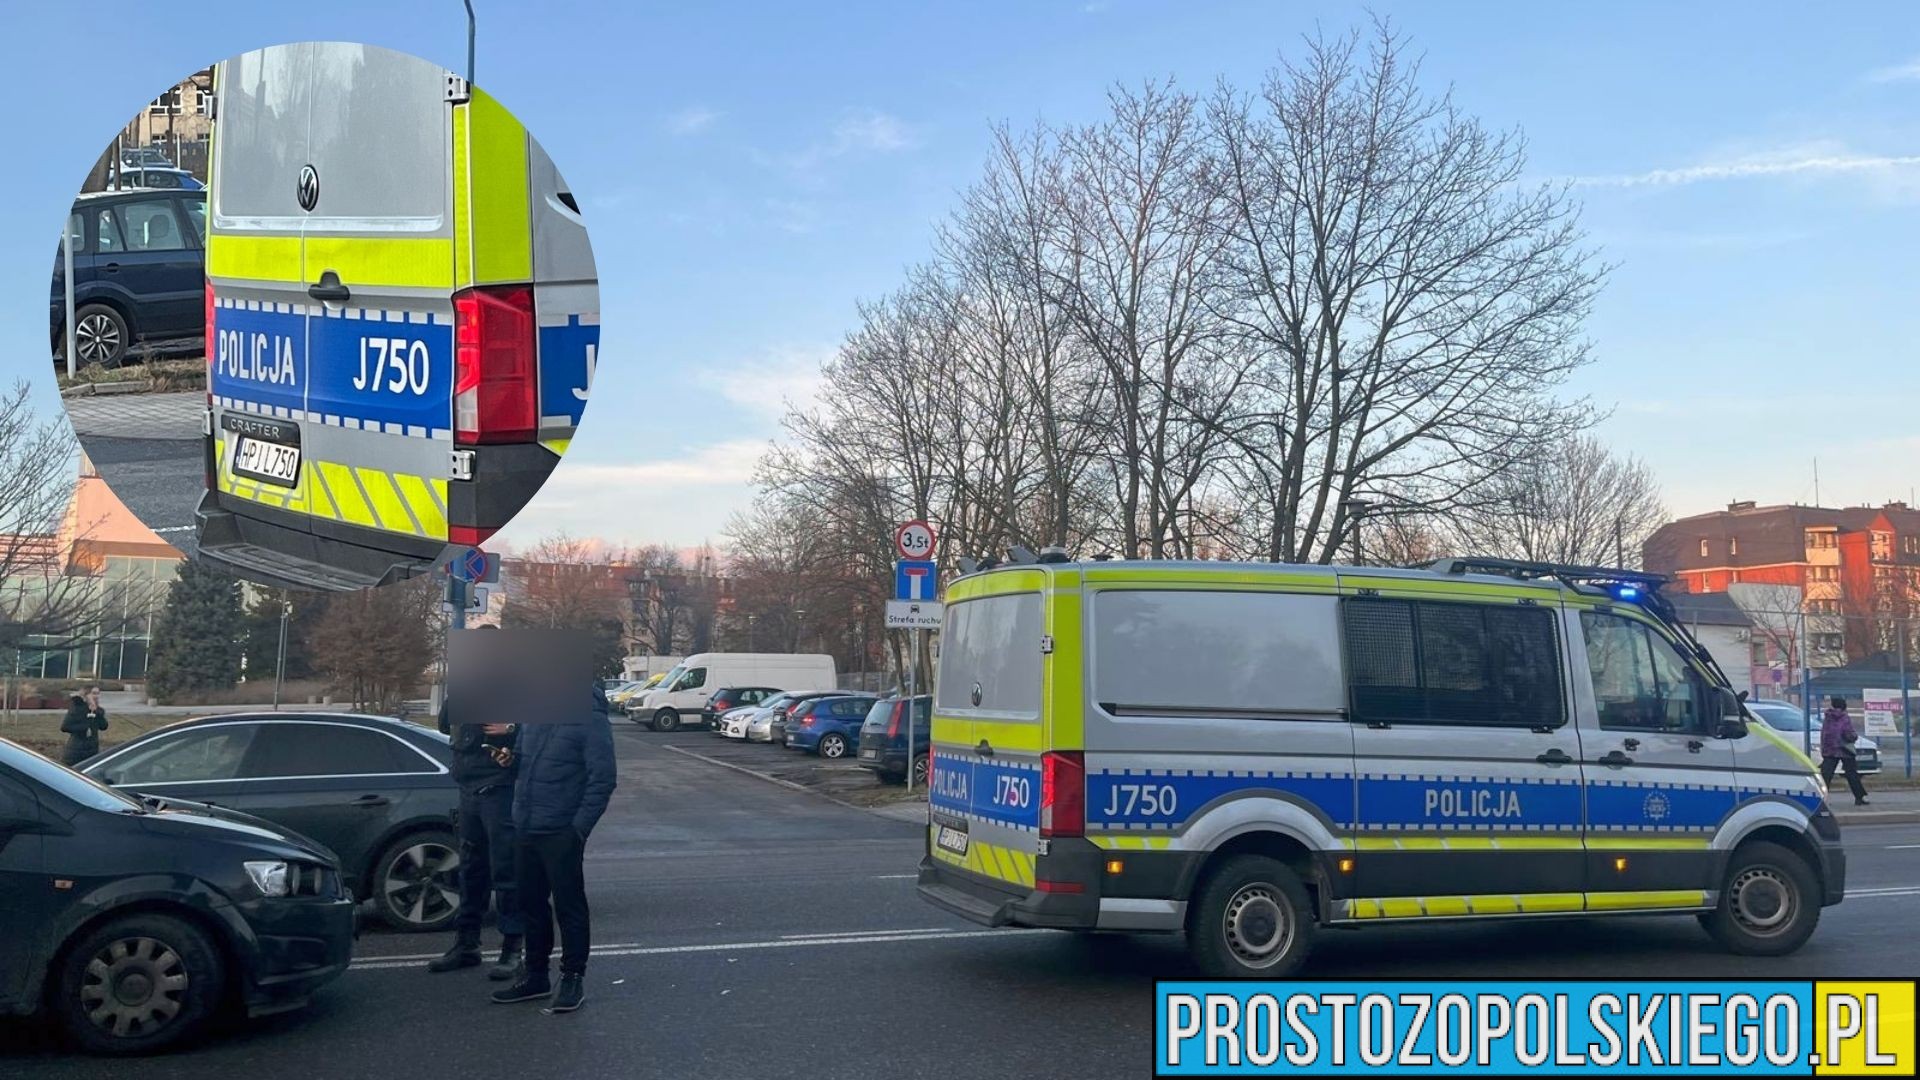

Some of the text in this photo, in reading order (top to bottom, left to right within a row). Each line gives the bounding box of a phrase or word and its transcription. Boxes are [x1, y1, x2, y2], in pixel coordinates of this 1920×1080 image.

[218, 329, 296, 386] POLICJA
[353, 336, 430, 396] J750
[230, 418, 280, 438] CRAFTER
[903, 532, 929, 549] 3,5t
[888, 615, 942, 624] Strefa ruchu
[934, 768, 968, 800] POLICJA
[993, 775, 1030, 808] J750
[1103, 784, 1177, 816] J750
[1425, 789, 1522, 818] POLICJA
